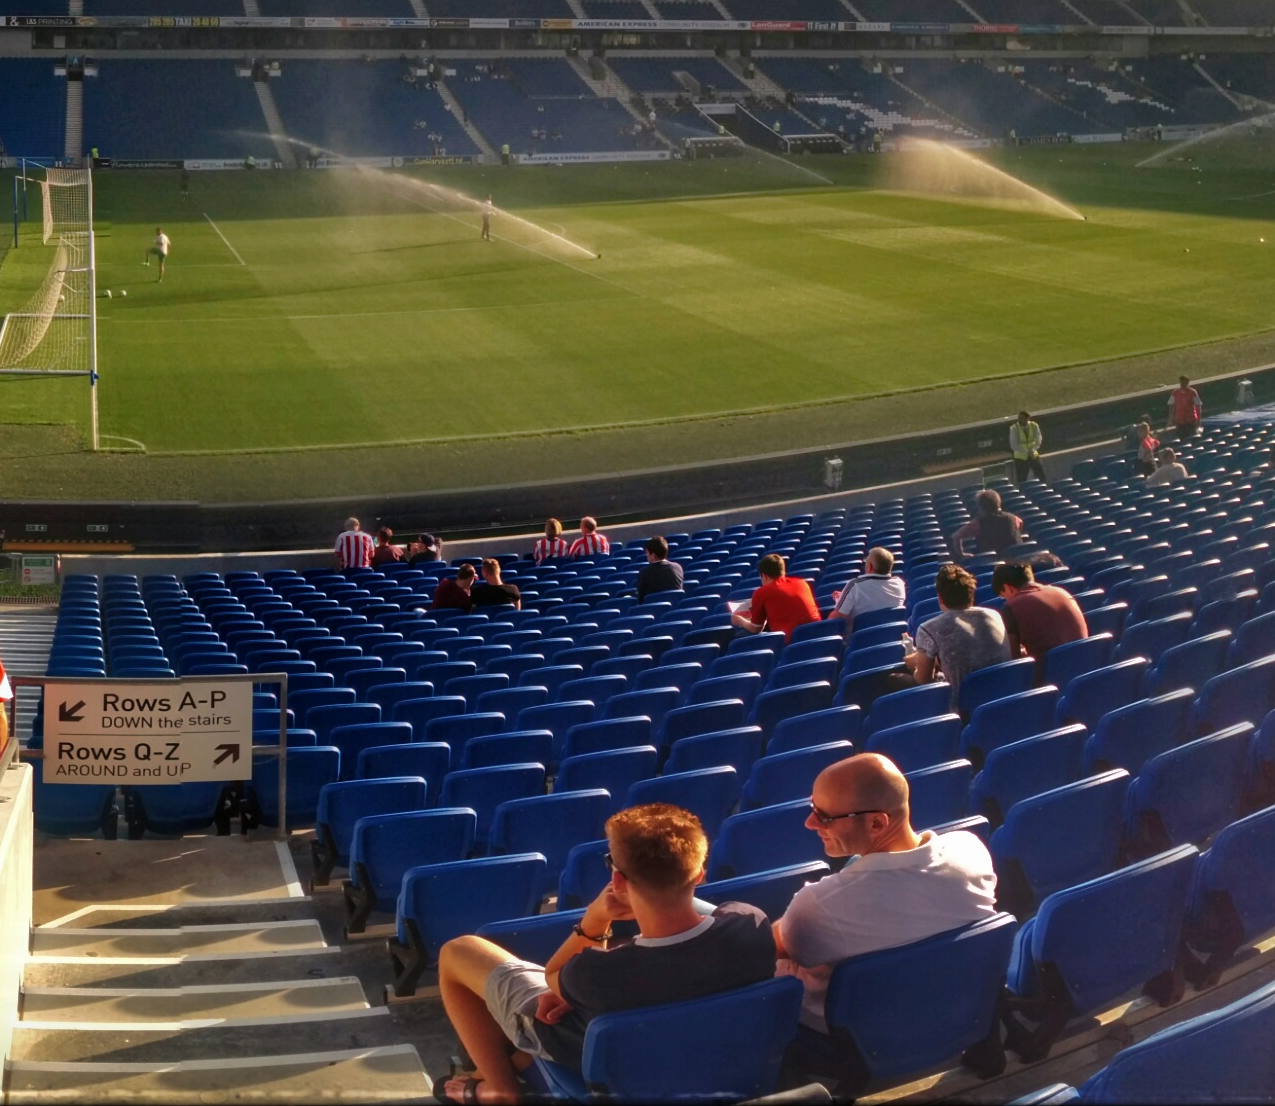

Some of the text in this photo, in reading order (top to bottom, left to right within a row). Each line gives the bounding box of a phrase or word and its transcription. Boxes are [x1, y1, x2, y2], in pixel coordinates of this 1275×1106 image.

[175, 17, 191, 26] TAXI
[815, 22, 829, 30] First
[102, 690, 226, 712] Rows A-P
[101, 713, 231, 729] DOWN the stairs
[58, 742, 180, 761] Rows Q-Z
[56, 762, 191, 777] AROUND and UP
